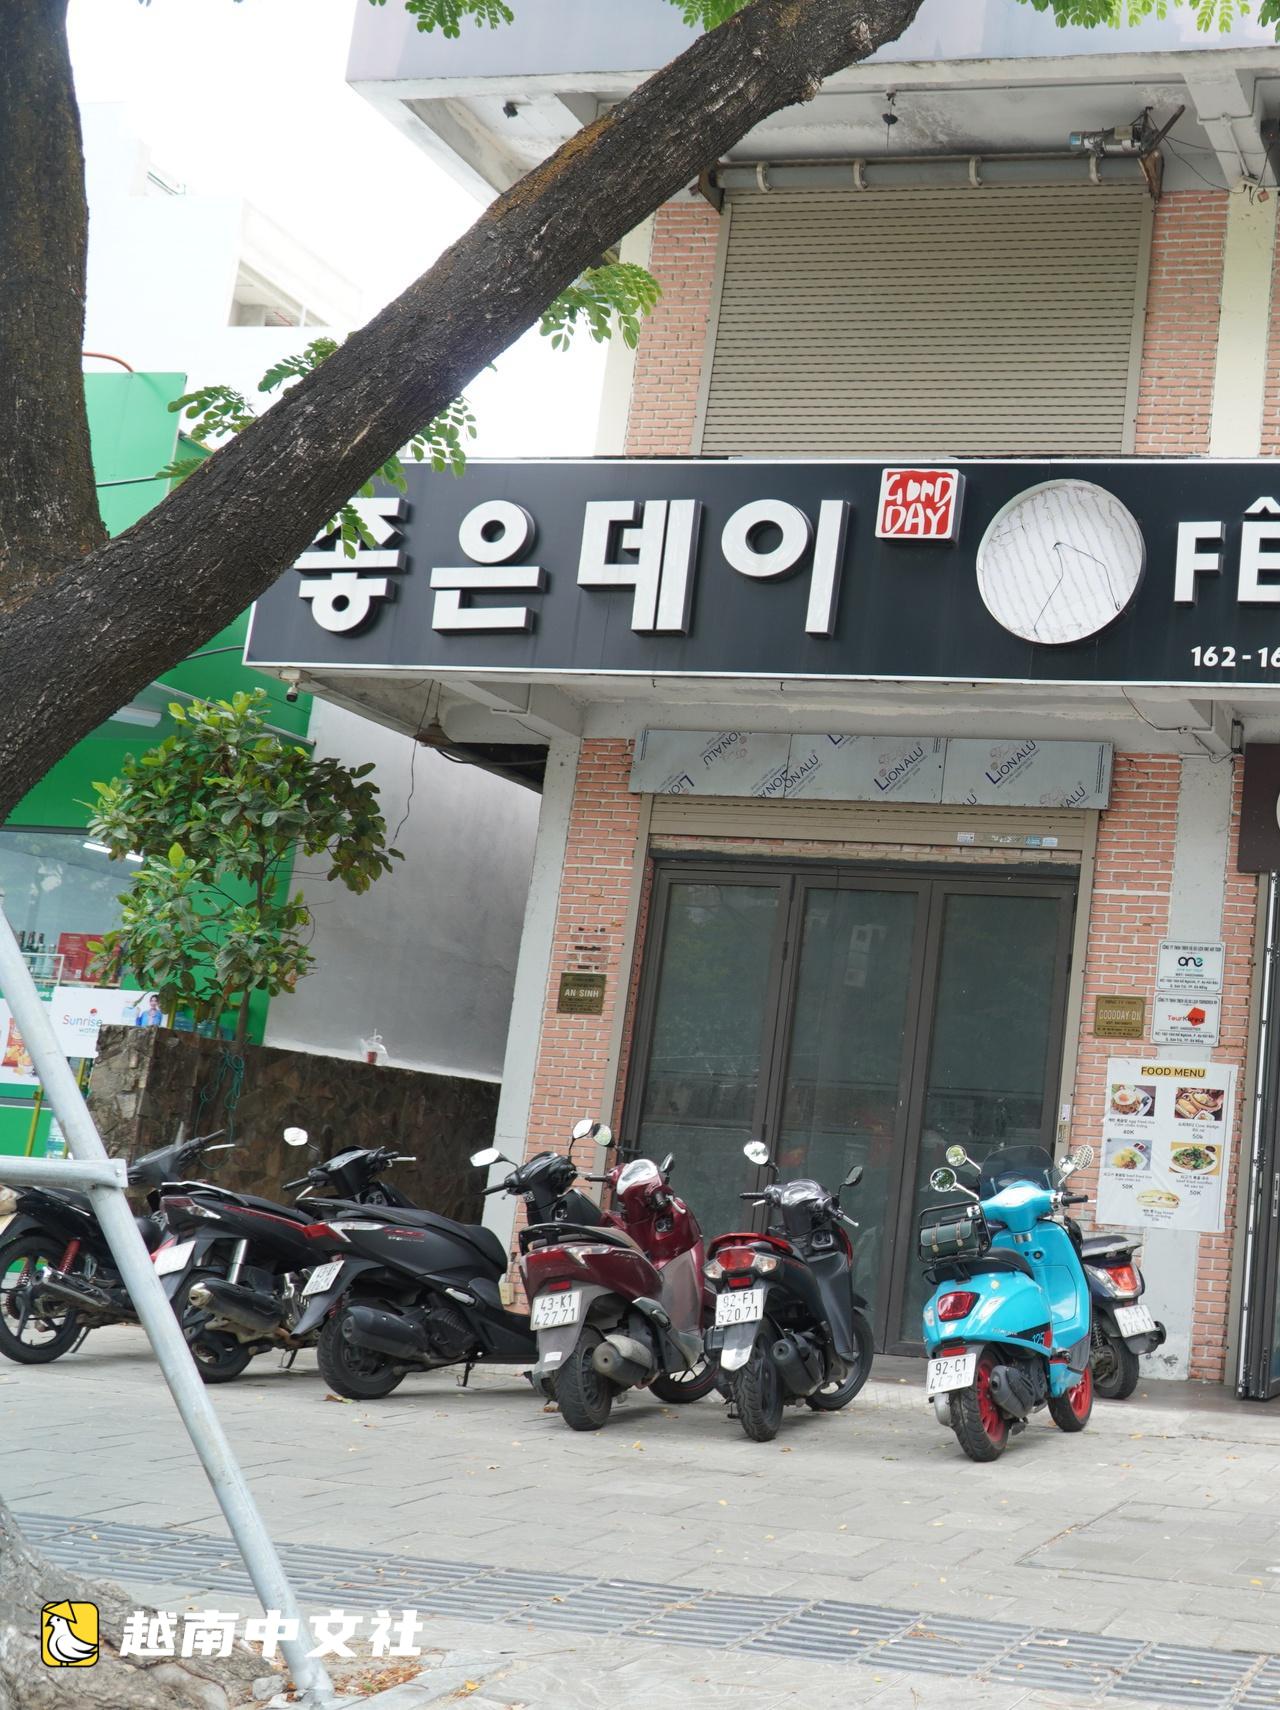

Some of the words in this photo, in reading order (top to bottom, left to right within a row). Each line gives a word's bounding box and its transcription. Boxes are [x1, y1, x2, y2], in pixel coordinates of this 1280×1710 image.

[884, 502, 947, 535] DAY
[564, 988, 576, 997] AN
[579, 989, 599, 998] SINH
[62, 1013, 103, 1027] Sunrise
[1141, 1066, 1171, 1076] FOOD
[1174, 1068, 1206, 1078] MENU
[540, 1294, 573, 1311] 43-K1
[534, 1308, 576, 1326] 427.71
